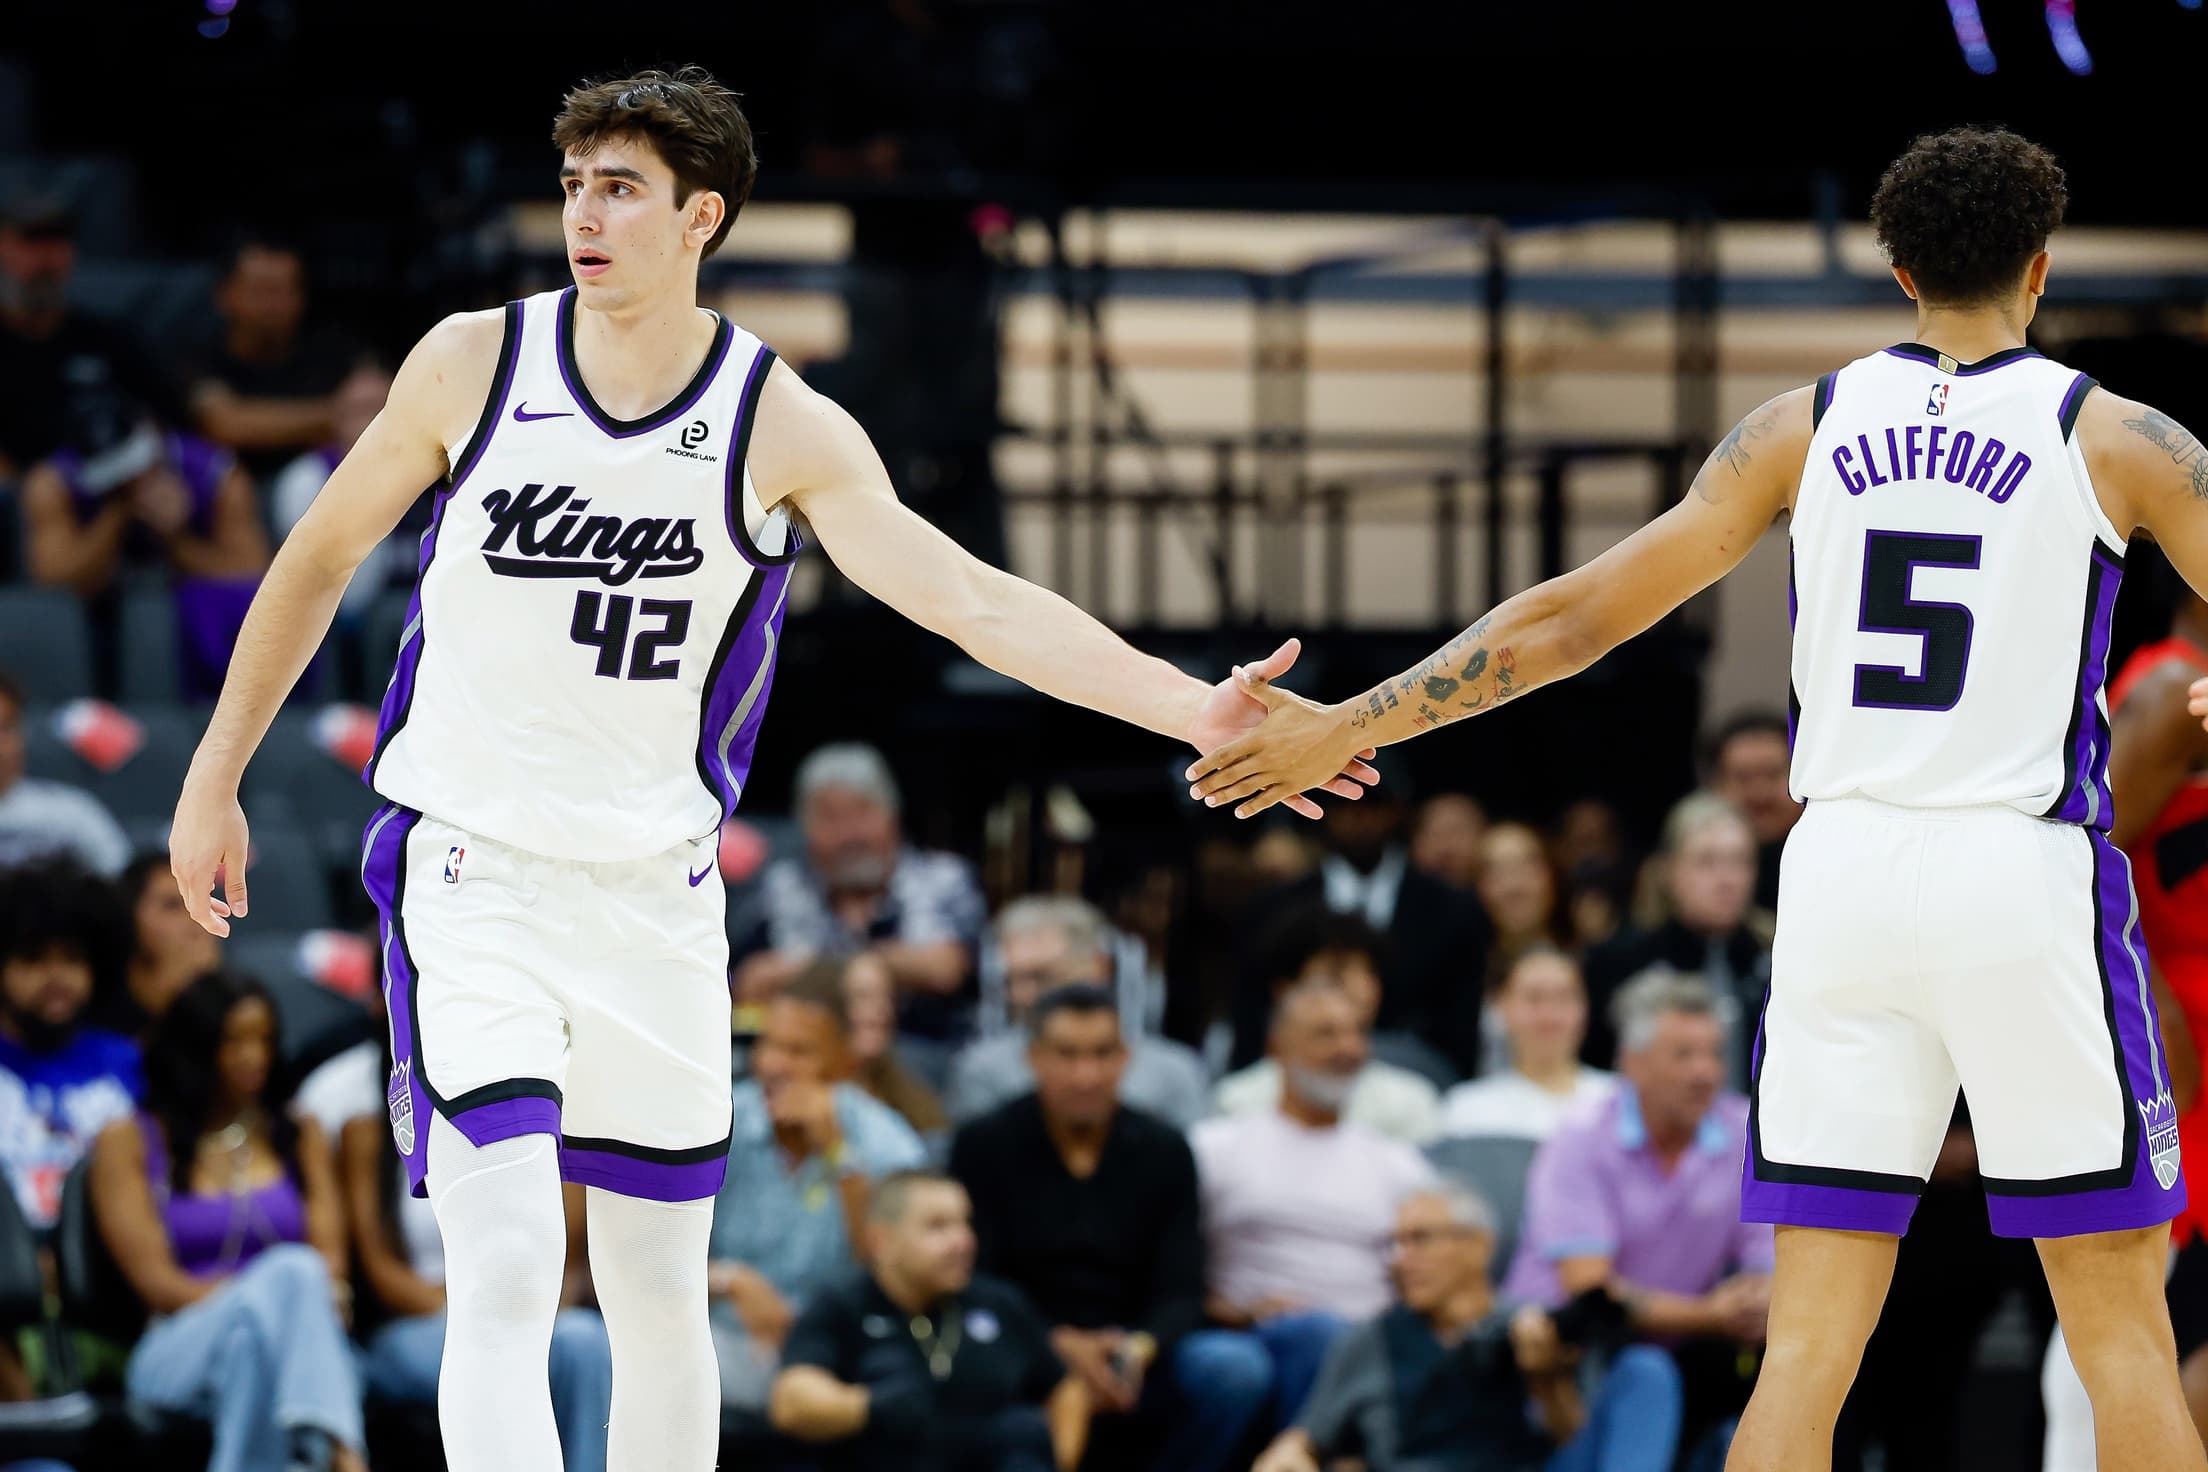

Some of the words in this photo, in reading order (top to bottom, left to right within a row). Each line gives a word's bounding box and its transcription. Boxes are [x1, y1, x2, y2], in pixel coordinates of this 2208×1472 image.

[666, 447, 699, 459] PHOONG
[699, 454, 718, 462] LAW
[1832, 425, 2032, 504] CLIFFORD
[480, 483, 705, 587] Kings
[570, 589, 693, 680] 42
[1852, 529, 1983, 711] 5
[2150, 1128, 2178, 1157] KINGS
